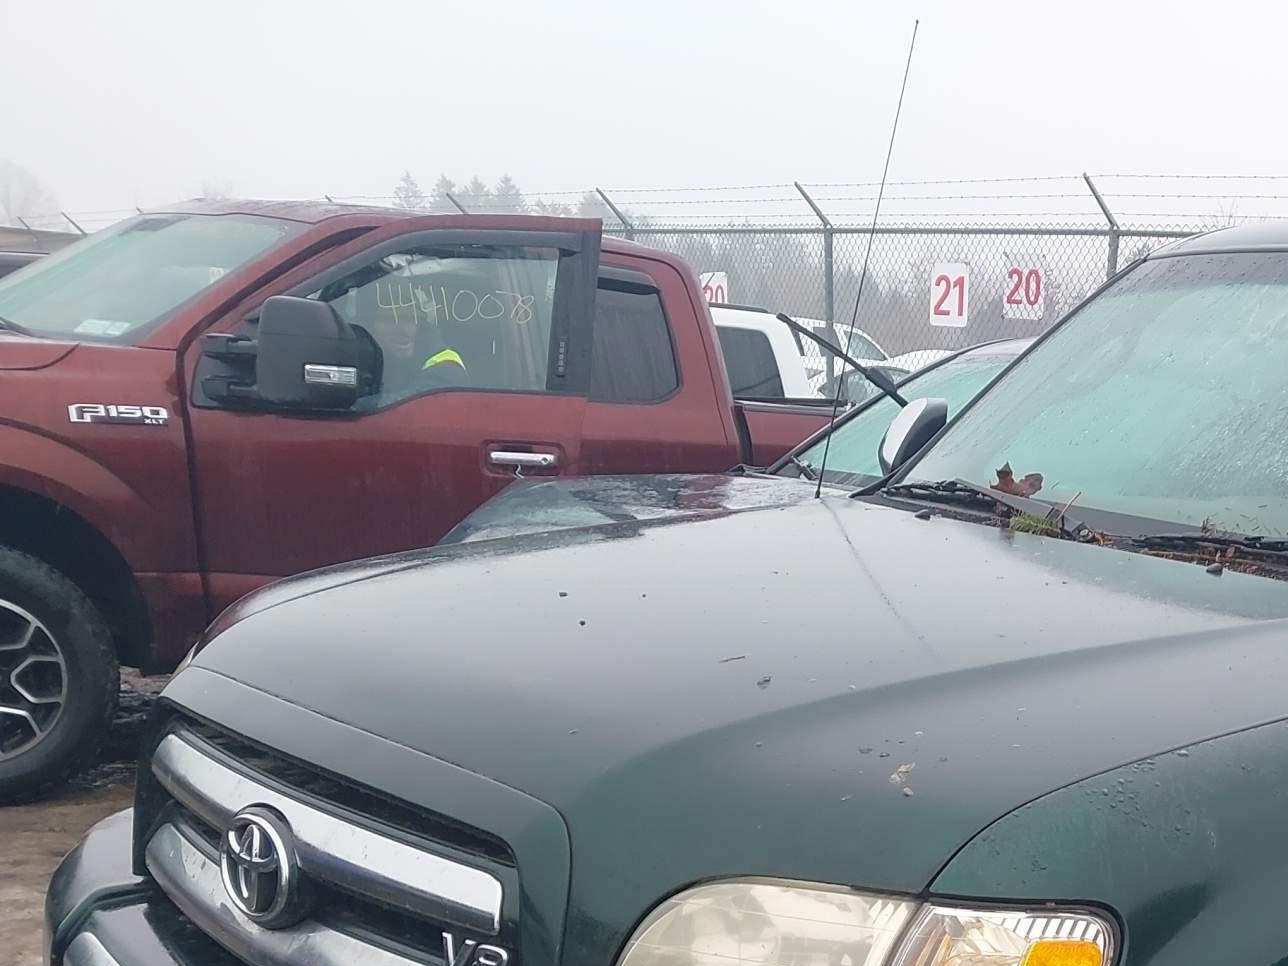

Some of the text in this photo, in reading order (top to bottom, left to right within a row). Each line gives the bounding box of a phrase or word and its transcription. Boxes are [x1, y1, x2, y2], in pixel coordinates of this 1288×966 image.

[376, 282, 535, 328] 44410078
[933, 274, 966, 317] 21
[1006, 267, 1042, 306] 20
